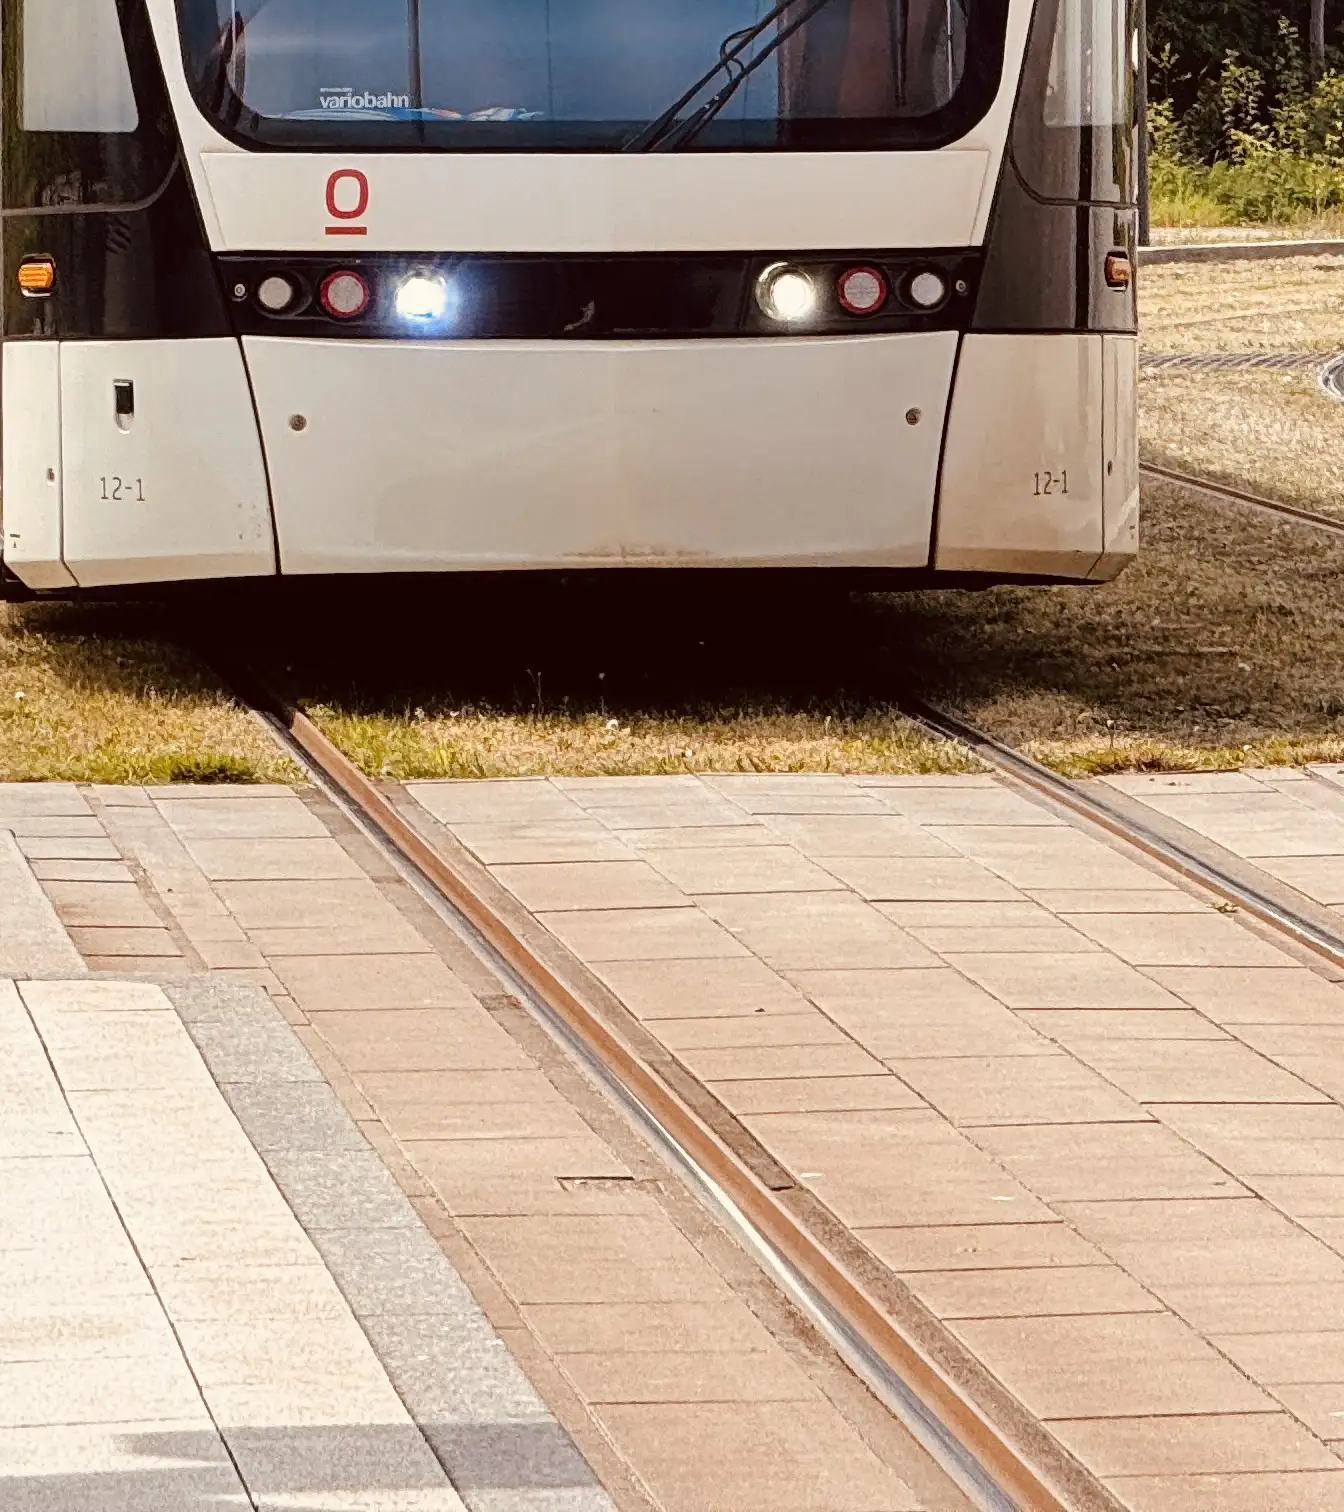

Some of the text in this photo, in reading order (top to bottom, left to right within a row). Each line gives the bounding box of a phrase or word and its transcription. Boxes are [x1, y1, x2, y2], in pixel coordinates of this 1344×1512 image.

[319, 92, 409, 108] variobahn
[100, 476, 146, 502] 12-1
[1032, 469, 1068, 496] 12-1
